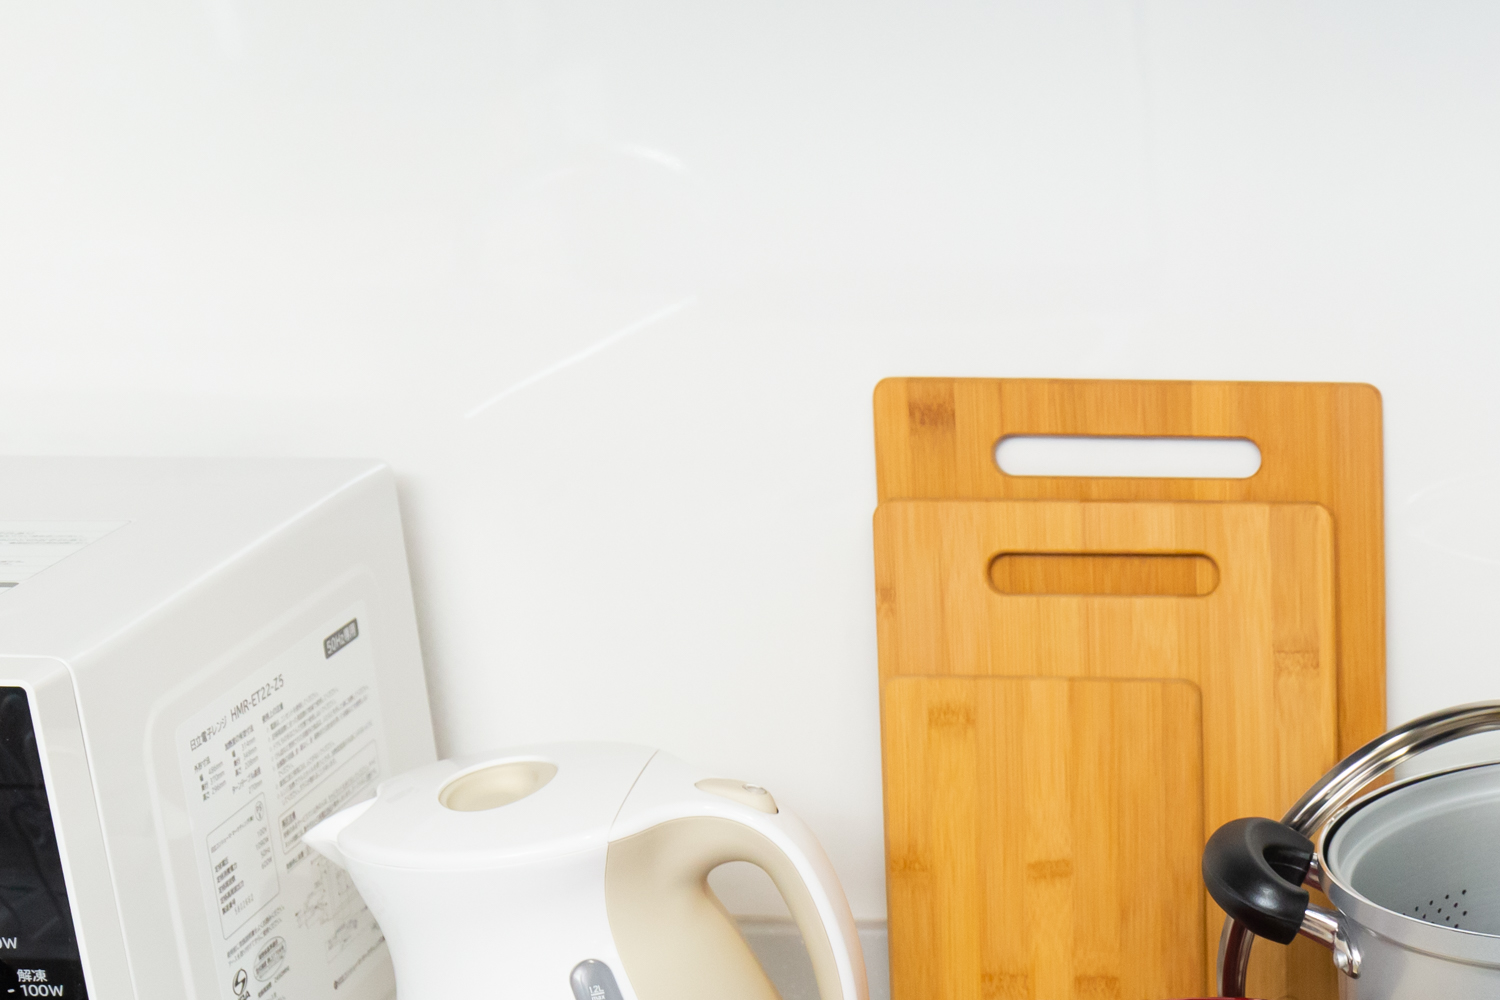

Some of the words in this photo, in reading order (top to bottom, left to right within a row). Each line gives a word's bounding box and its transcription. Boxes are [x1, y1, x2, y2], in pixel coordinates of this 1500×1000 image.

[0, 937, 17, 949] W
[16, 968, 48, 983] 解凍
[20, 984, 63, 997] 100W
